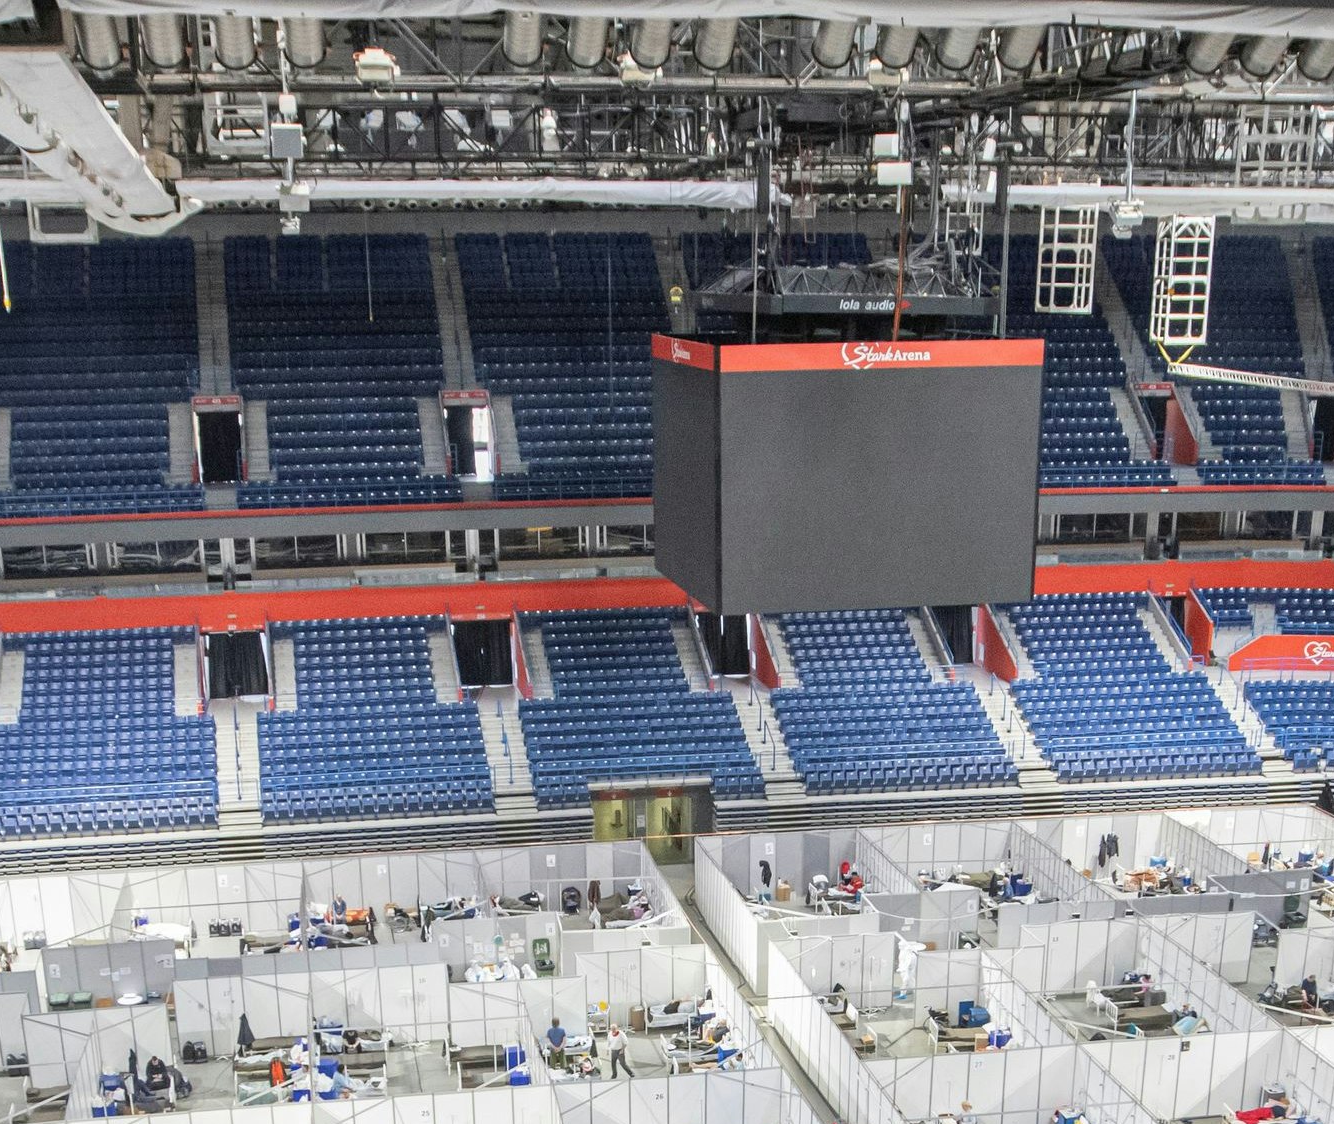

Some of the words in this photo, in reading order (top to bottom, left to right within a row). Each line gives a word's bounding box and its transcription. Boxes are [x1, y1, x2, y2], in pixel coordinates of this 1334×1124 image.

[839, 298, 860, 311] lola
[864, 298, 896, 312] audio
[893, 349, 931, 361] Arena
